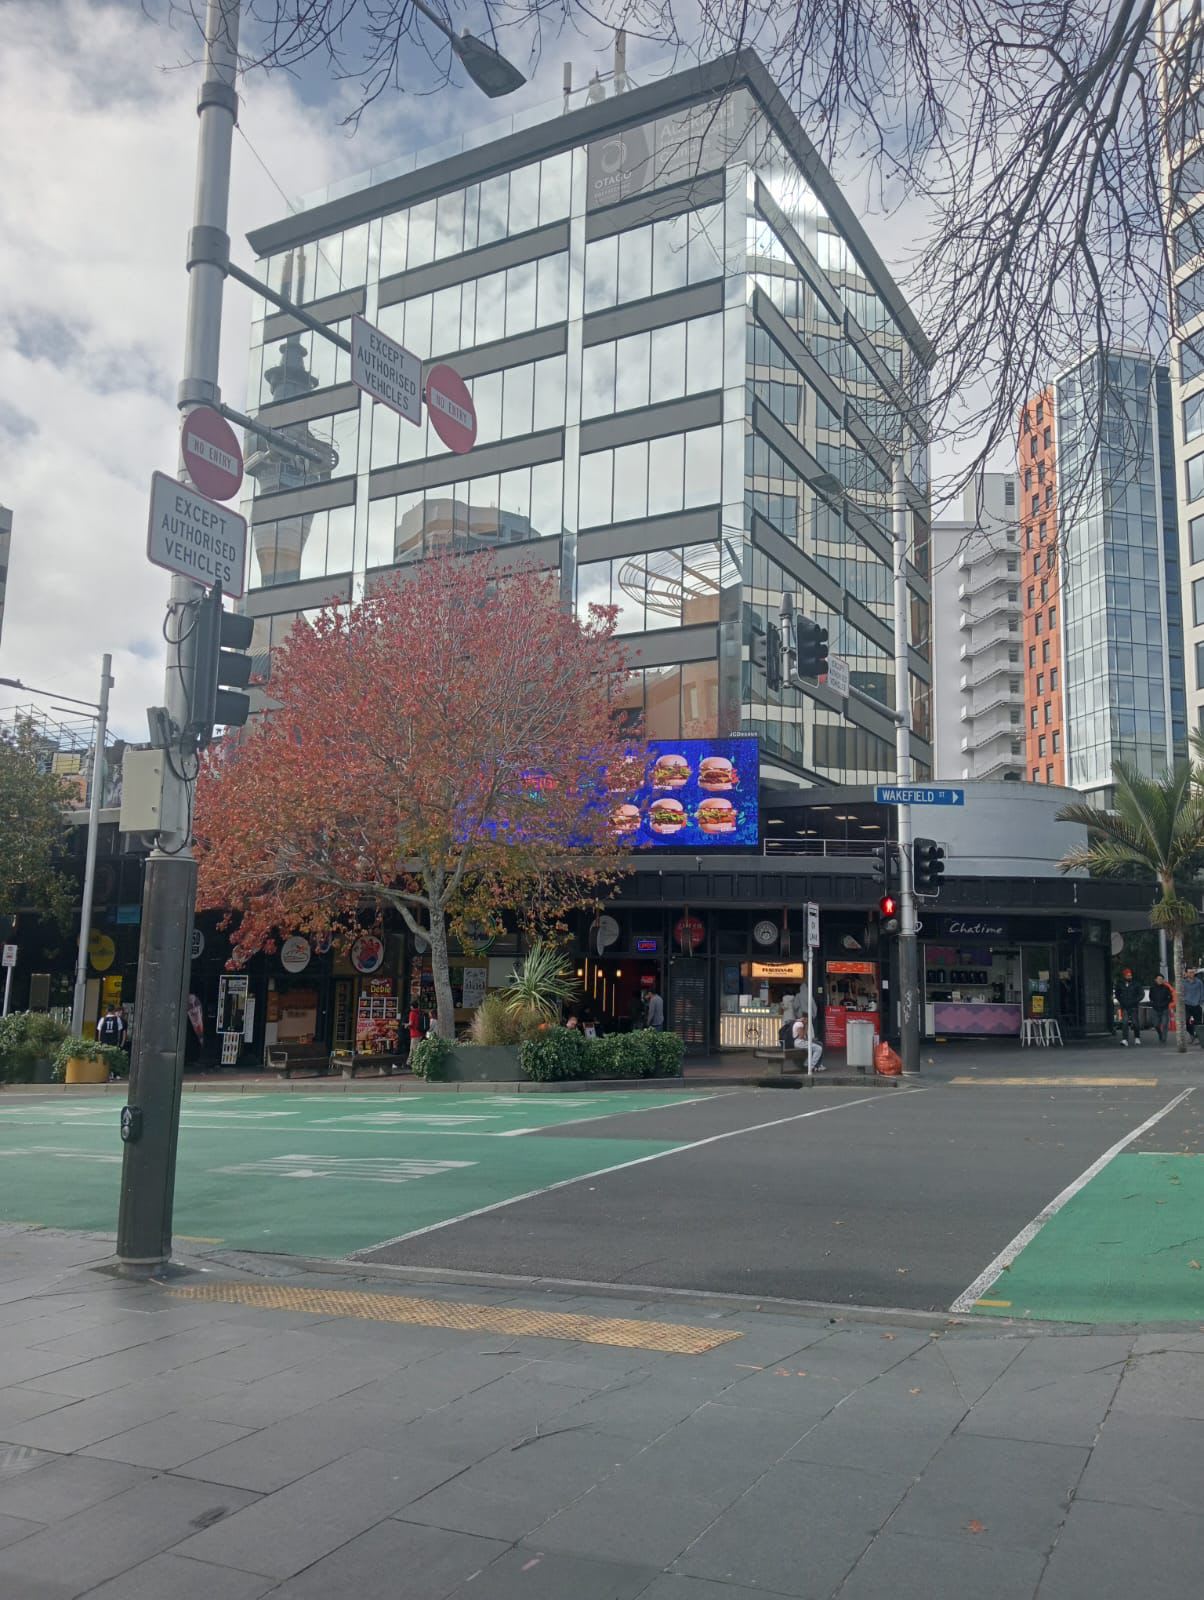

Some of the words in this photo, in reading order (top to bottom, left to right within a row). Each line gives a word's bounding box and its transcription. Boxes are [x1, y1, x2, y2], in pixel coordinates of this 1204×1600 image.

[369, 333, 405, 368] EXCEPT
[357, 348, 416, 396] AUTHORISED
[364, 369, 409, 410] VEHICLES
[435, 394, 446, 409] NO
[447, 400, 467, 424] ENTRY
[193, 442, 205, 456] NO
[209, 450, 232, 471] ENTRY
[175, 495, 227, 534] EXCEPT
[161, 513, 236, 562] AUTHORISED
[165, 538, 231, 583] VEHICLES
[882, 789, 935, 802] WAKEFIELD
[938, 791, 945, 799] ST
[949, 922, 1004, 935] Chatime
